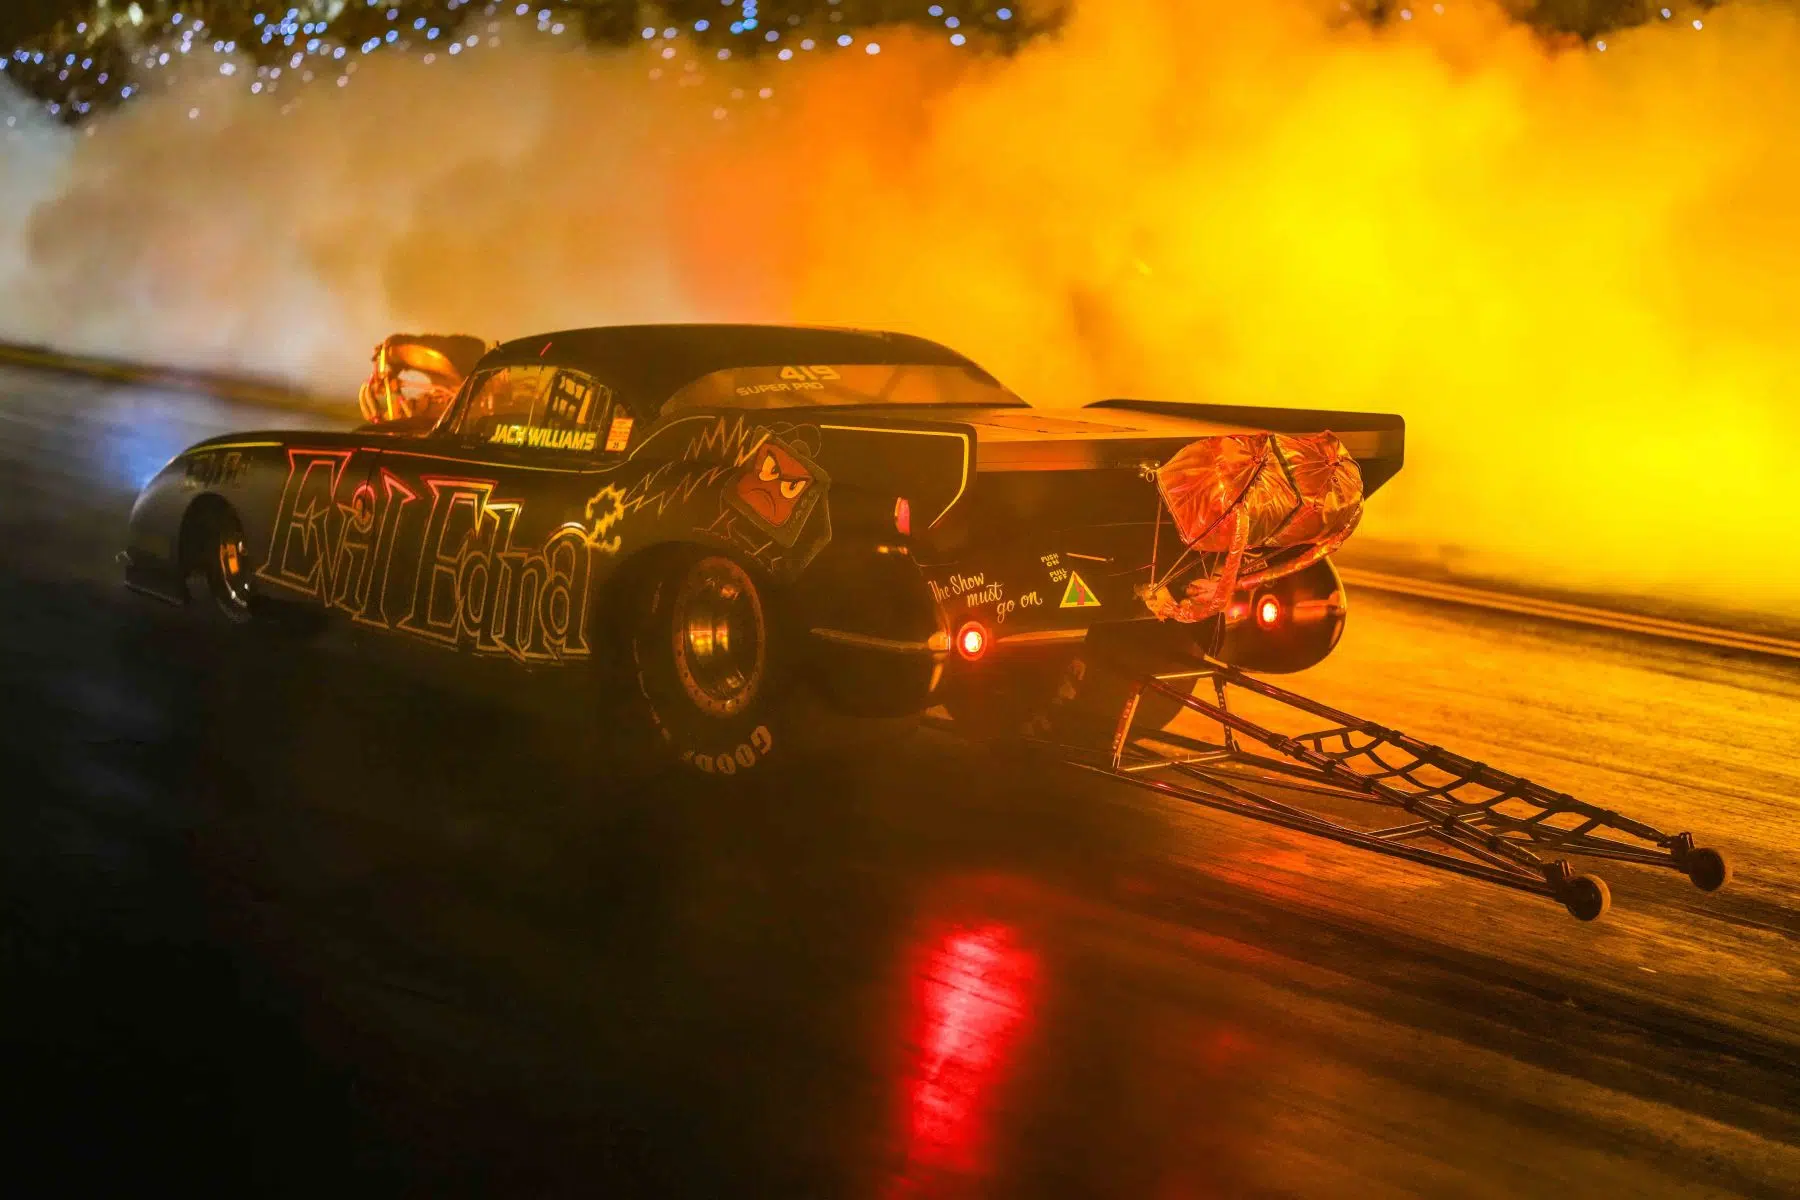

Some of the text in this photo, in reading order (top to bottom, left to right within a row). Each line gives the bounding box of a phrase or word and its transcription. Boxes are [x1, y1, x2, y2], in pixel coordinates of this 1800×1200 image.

[780, 365, 841, 380] 419
[736, 382, 825, 396] SUPER PRO
[487, 424, 529, 447] JACK
[528, 427, 597, 451] WILLIAMS
[255, 447, 417, 629] Evil
[396, 475, 591, 661] Edna
[1040, 552, 1060, 563] PUSH
[1046, 559, 1060, 567] ON
[1049, 567, 1068, 578] PULL
[1052, 573, 1068, 583] OFF
[928, 572, 985, 603] The Show
[966, 581, 1004, 608] must
[996, 591, 1044, 624] go on
